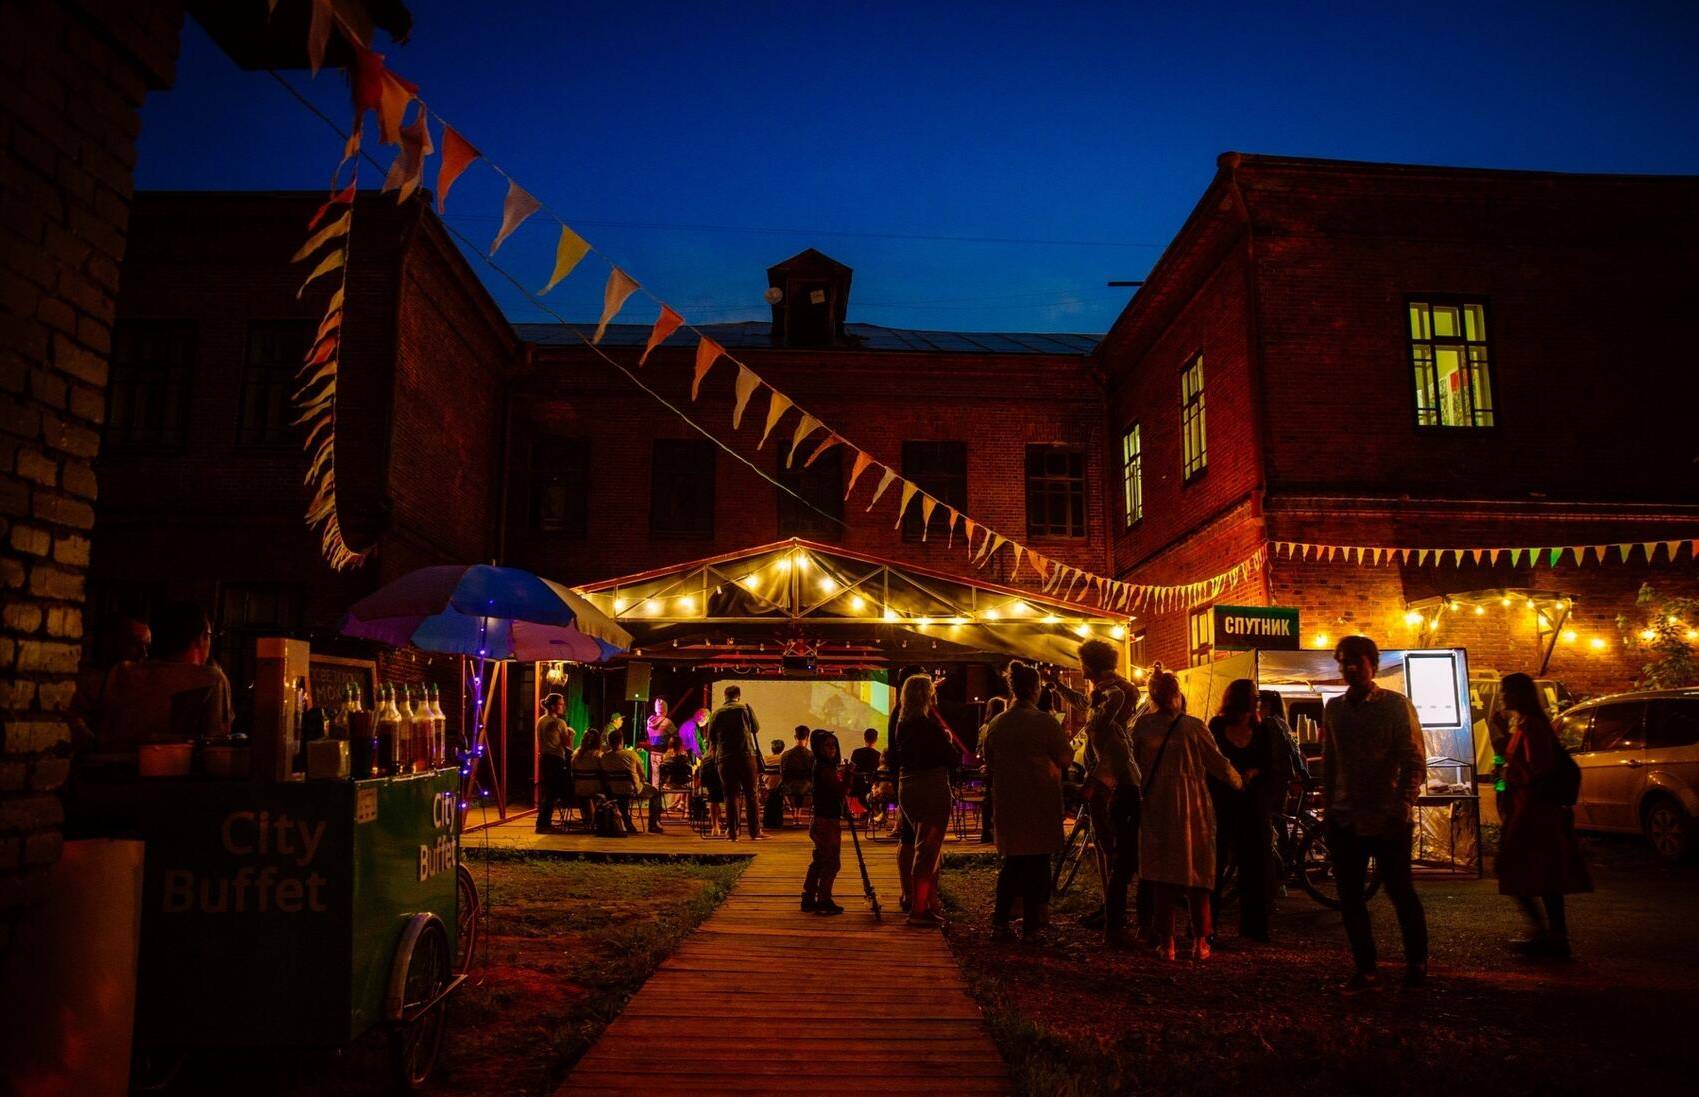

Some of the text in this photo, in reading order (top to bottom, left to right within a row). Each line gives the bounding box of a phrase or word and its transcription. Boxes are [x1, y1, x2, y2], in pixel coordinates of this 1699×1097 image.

[1225, 616, 1290, 636] СПУТНИК
[432, 792, 457, 833] City
[222, 808, 328, 866] City
[420, 834, 457, 881] Buffet
[161, 865, 328, 913] Buffet
